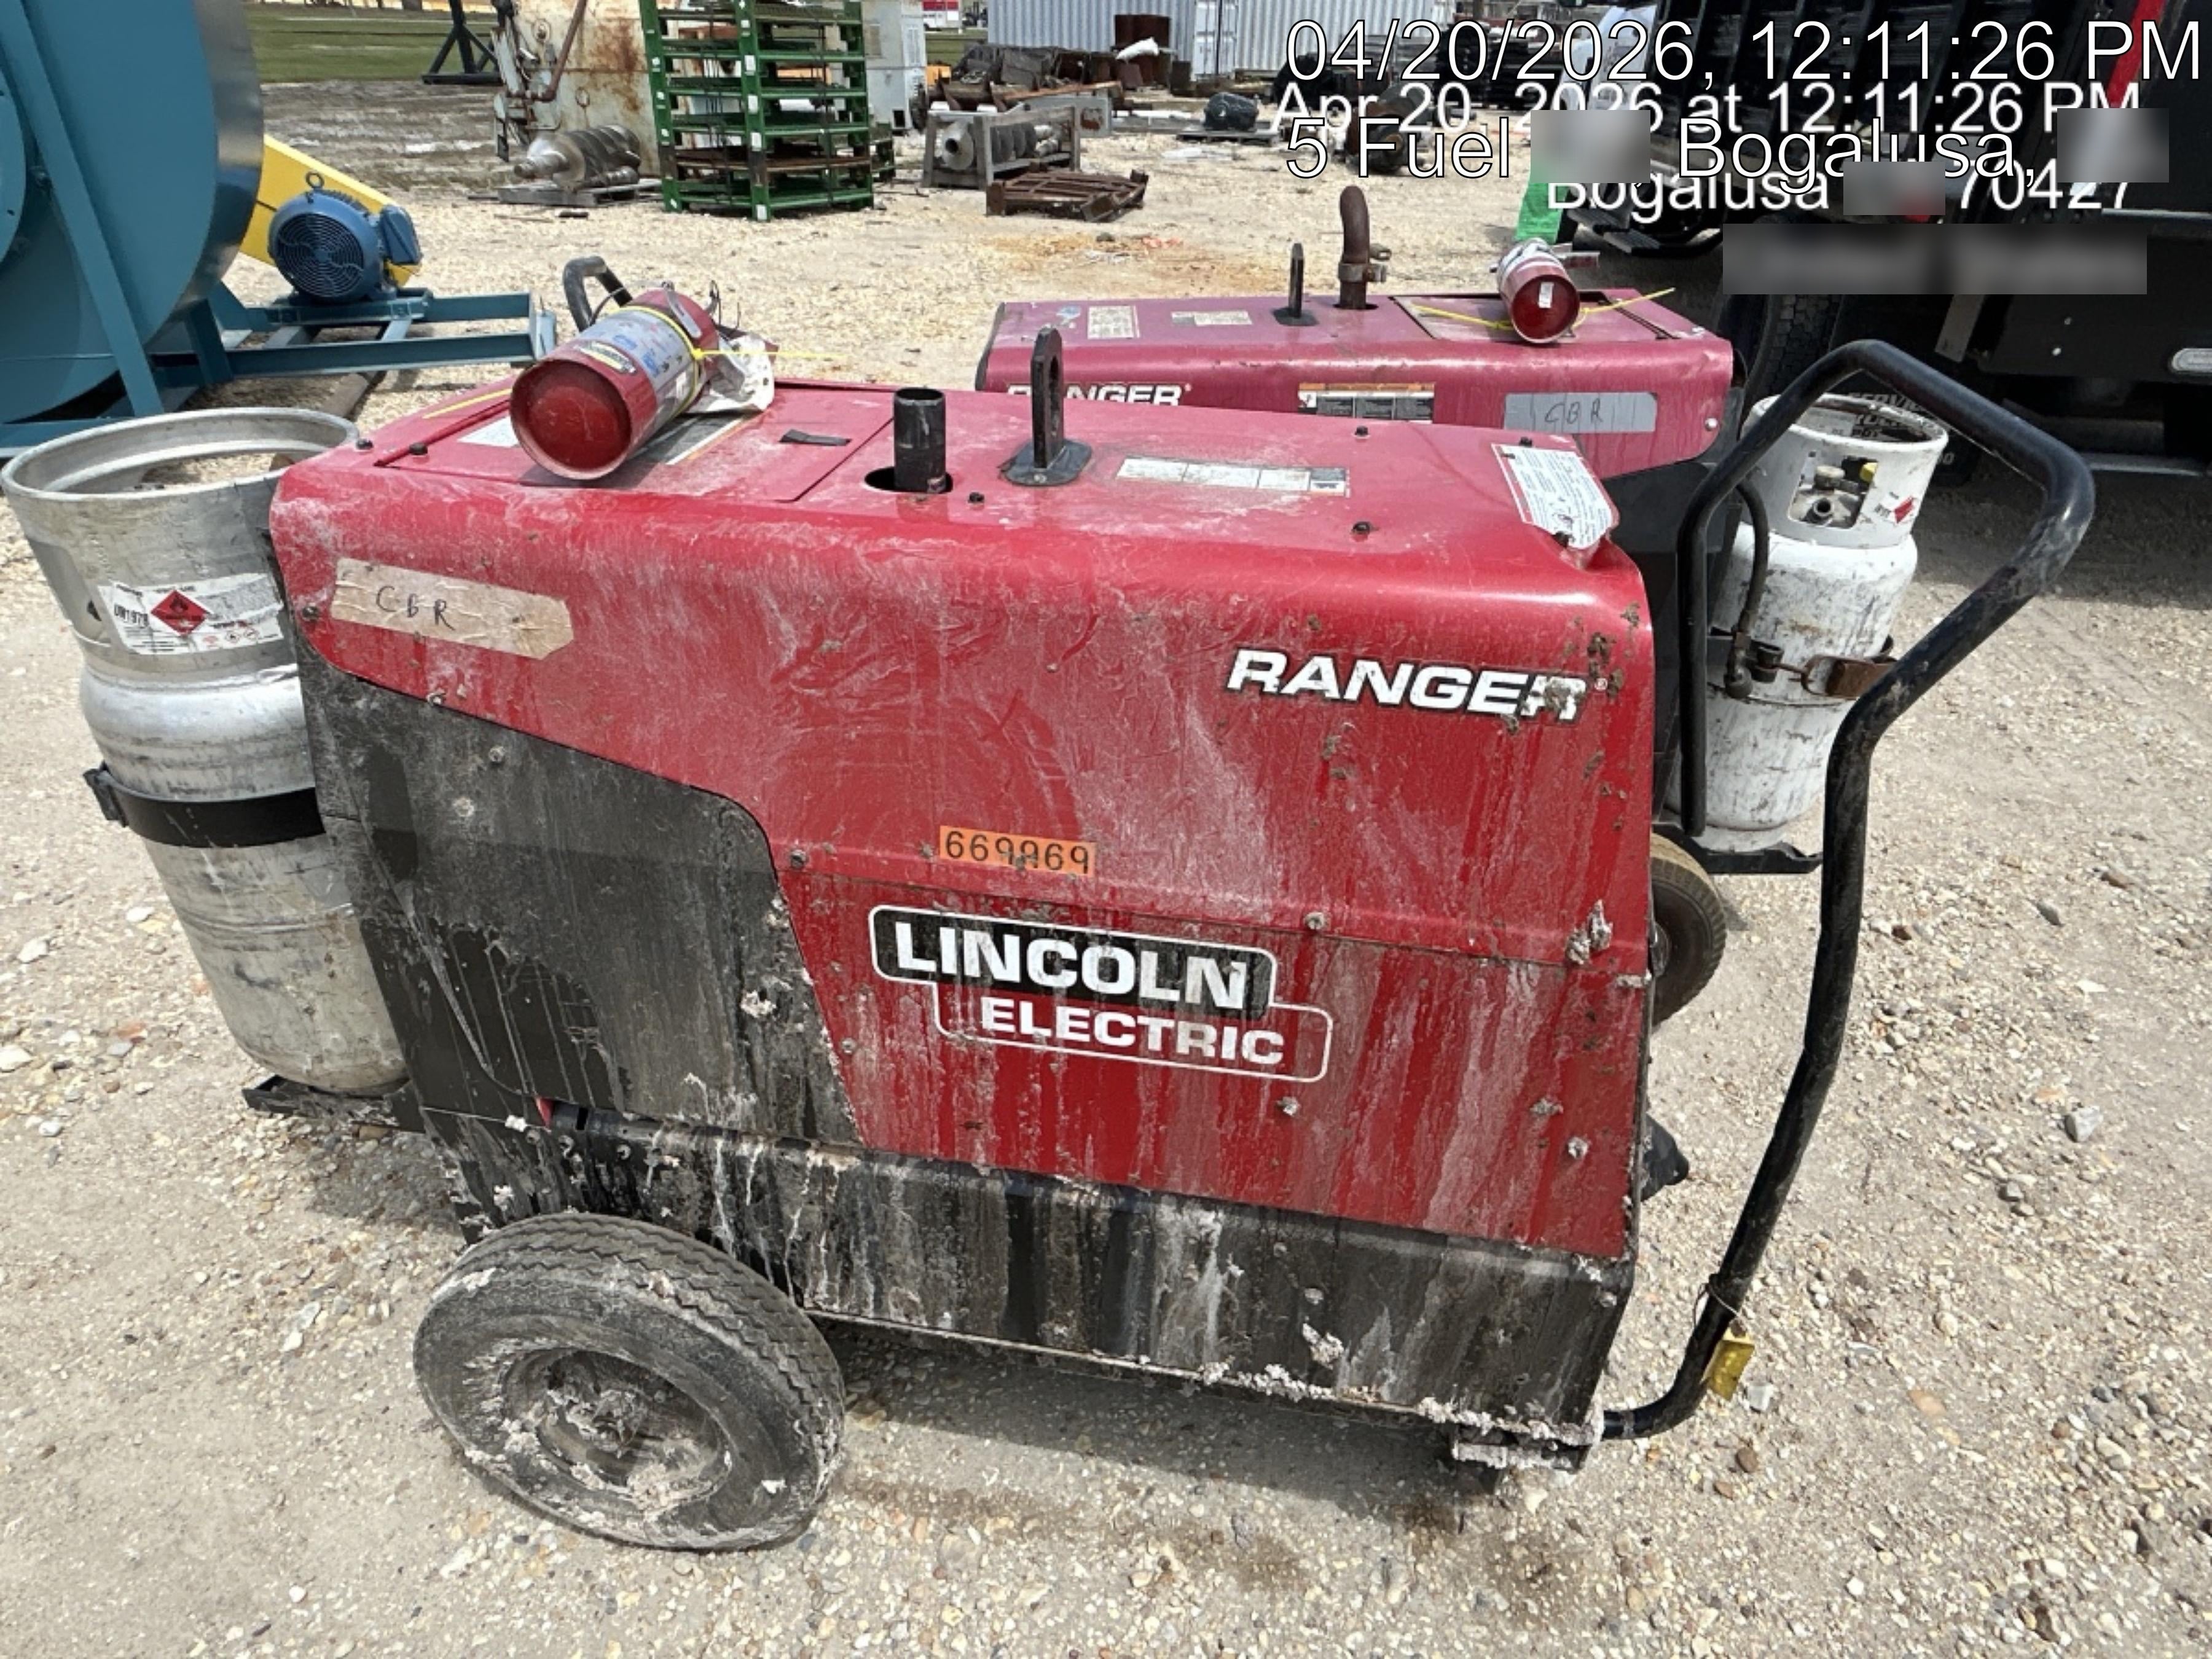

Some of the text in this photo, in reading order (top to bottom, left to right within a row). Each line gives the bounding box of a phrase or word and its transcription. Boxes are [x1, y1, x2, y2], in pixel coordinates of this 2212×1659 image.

[1008, 385, 1182, 406] NGER
[895, 922, 1249, 1011] LINCOLN
[981, 997, 1285, 1066] ELECTRIC
